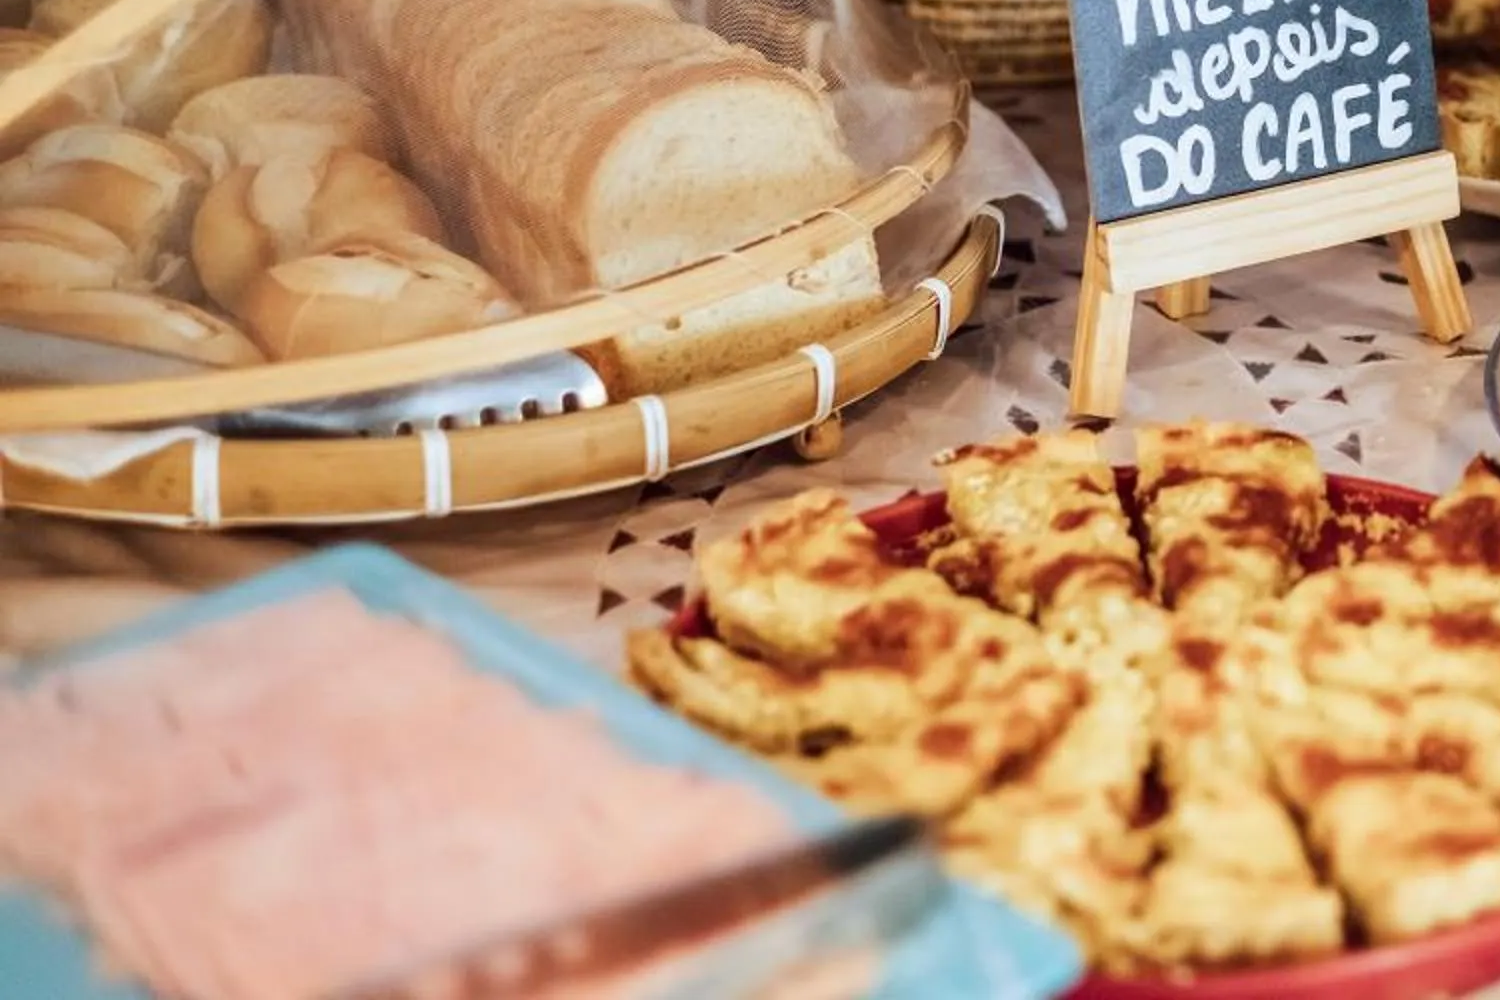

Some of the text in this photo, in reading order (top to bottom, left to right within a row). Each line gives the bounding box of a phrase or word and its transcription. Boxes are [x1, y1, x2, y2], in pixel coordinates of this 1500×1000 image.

[1119, 41, 1413, 207] DO CAFÉ
[1133, 5, 1380, 125] depois
